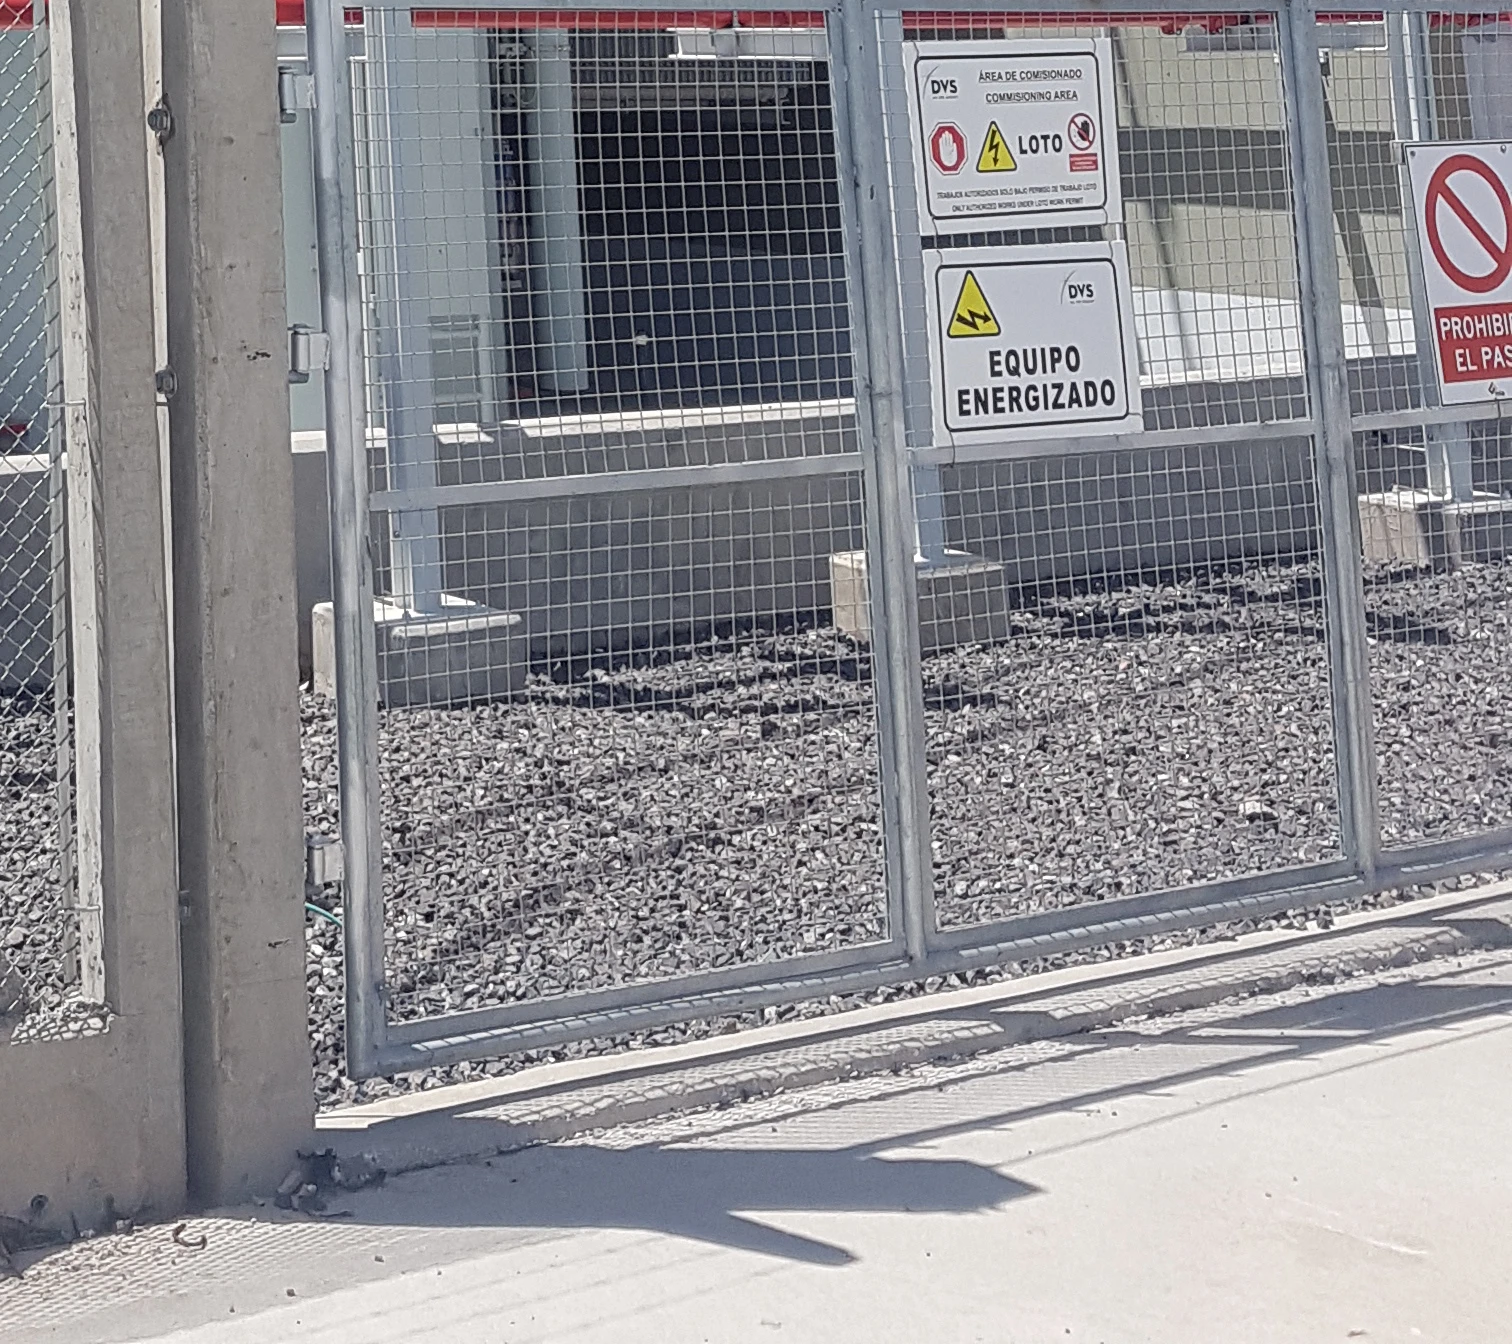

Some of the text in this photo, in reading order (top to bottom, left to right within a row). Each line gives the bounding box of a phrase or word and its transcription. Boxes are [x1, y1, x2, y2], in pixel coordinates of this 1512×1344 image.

[979, 70, 1003, 82] ÁREA
[1005, 71, 1017, 81] DE
[931, 80, 957, 94] DVS
[1053, 90, 1078, 101] AREA
[1018, 134, 1063, 155] LOTO
[1068, 284, 1094, 299] DVS
[989, 345, 1081, 378] EQUIPO
[1455, 348, 1478, 372] EL
[958, 379, 1116, 417] ENERGIZADO
